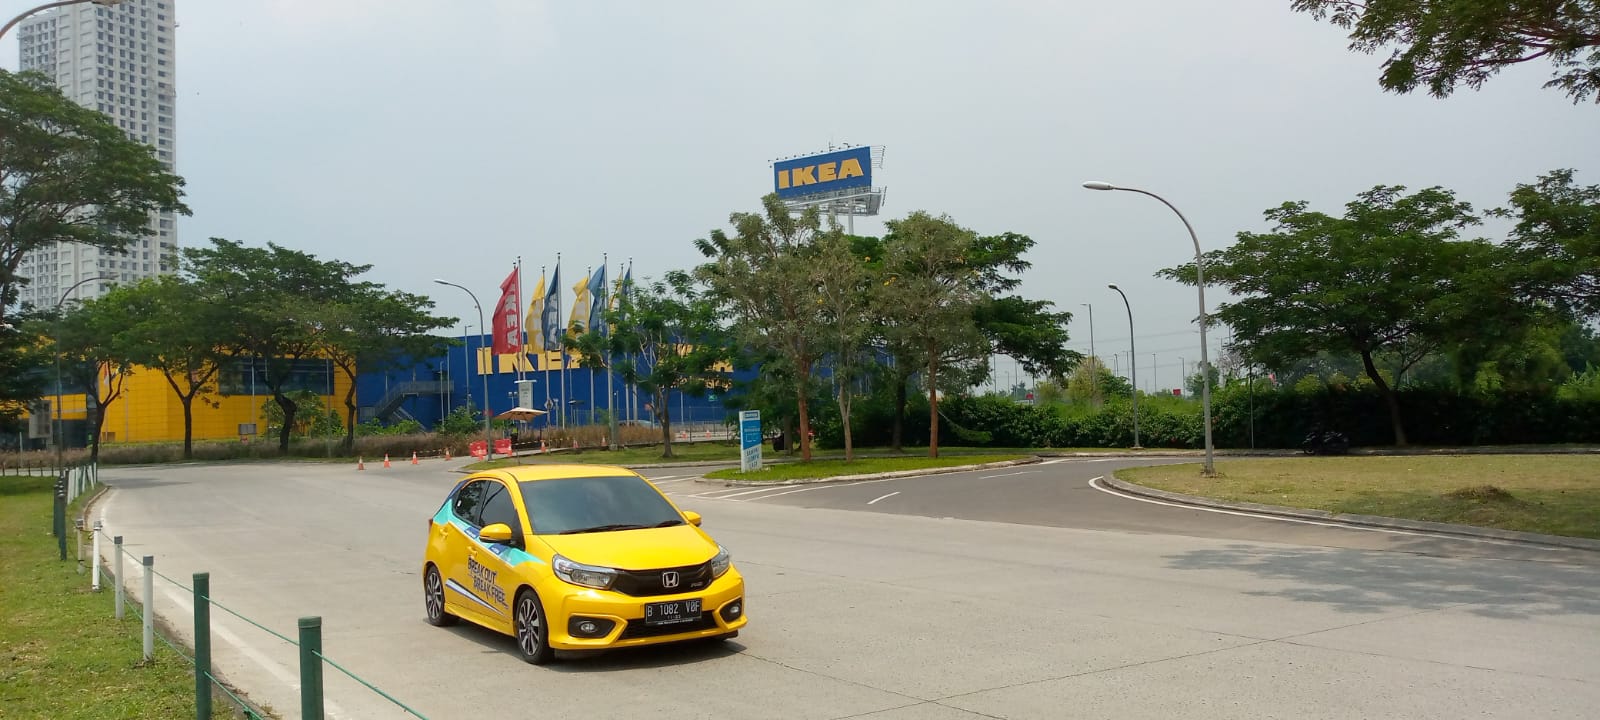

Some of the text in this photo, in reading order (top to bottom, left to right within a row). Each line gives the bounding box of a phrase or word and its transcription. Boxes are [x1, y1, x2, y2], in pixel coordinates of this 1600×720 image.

[778, 158, 864, 189] IKEA
[505, 282, 519, 347] IKEA
[467, 556, 498, 584] BREAK OUT
[474, 575, 507, 604] BREAK FREE
[647, 606, 653, 617] B
[660, 603, 679, 616] 1082
